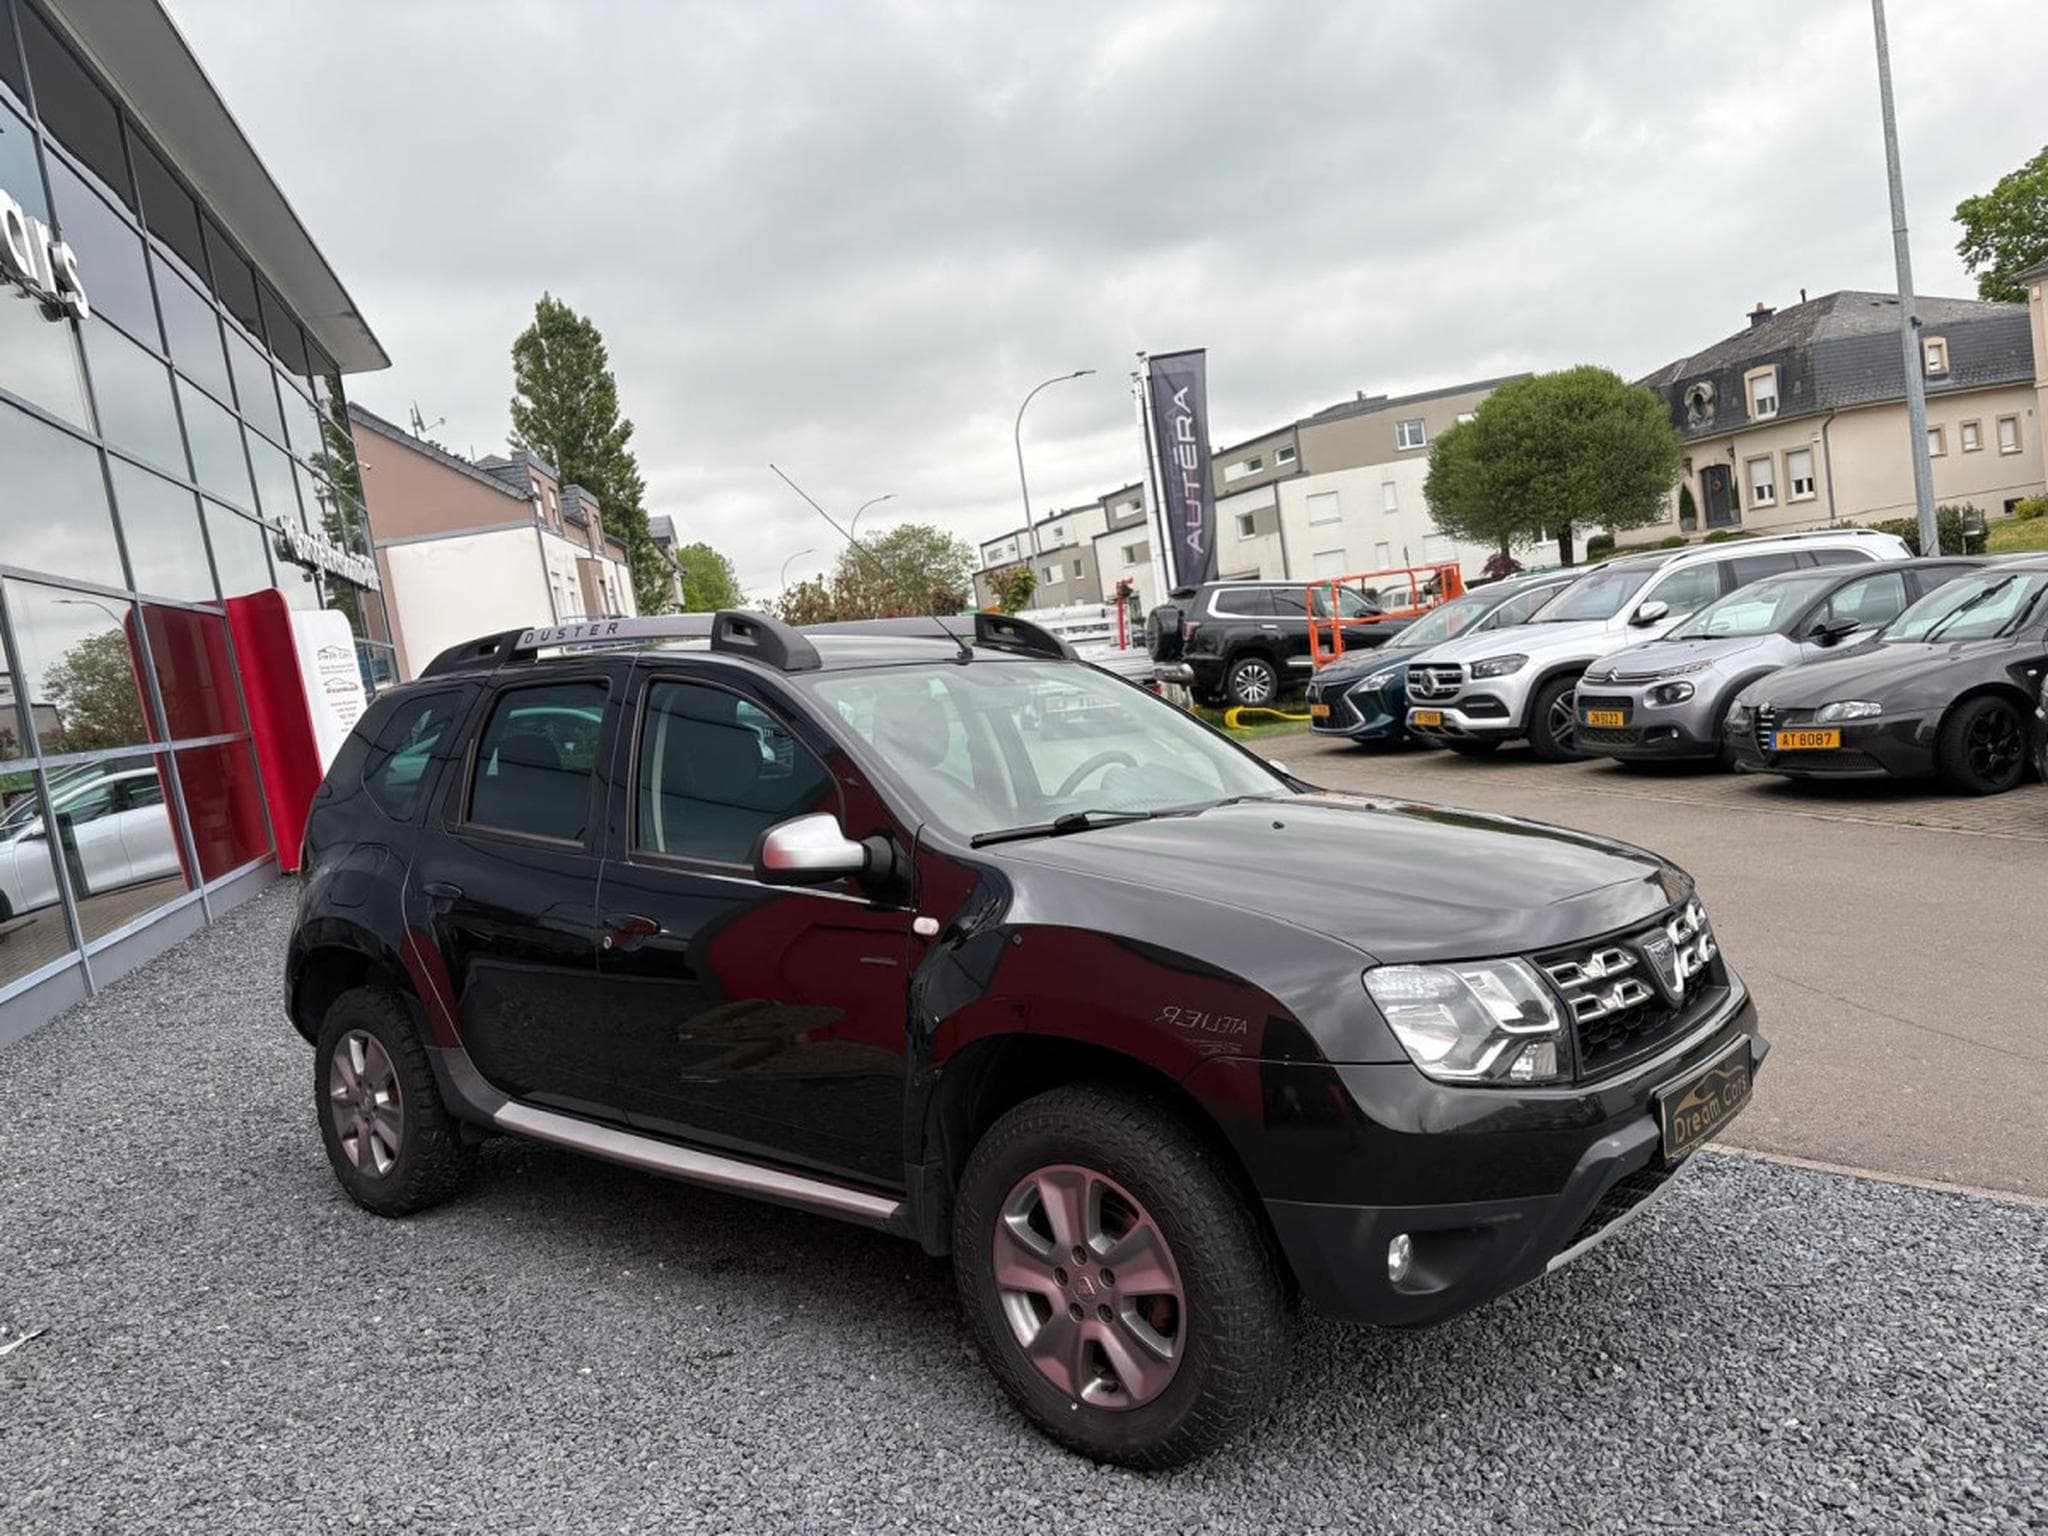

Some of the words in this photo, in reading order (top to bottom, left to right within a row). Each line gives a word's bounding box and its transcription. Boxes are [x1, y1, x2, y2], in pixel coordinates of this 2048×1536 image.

[524, 622, 618, 644] DUSTER
[1782, 733, 1796, 746] AT
[1800, 732, 1832, 746] 8087
[1674, 1097, 1721, 1144] Dream
[1723, 1074, 1747, 1106] Cars
